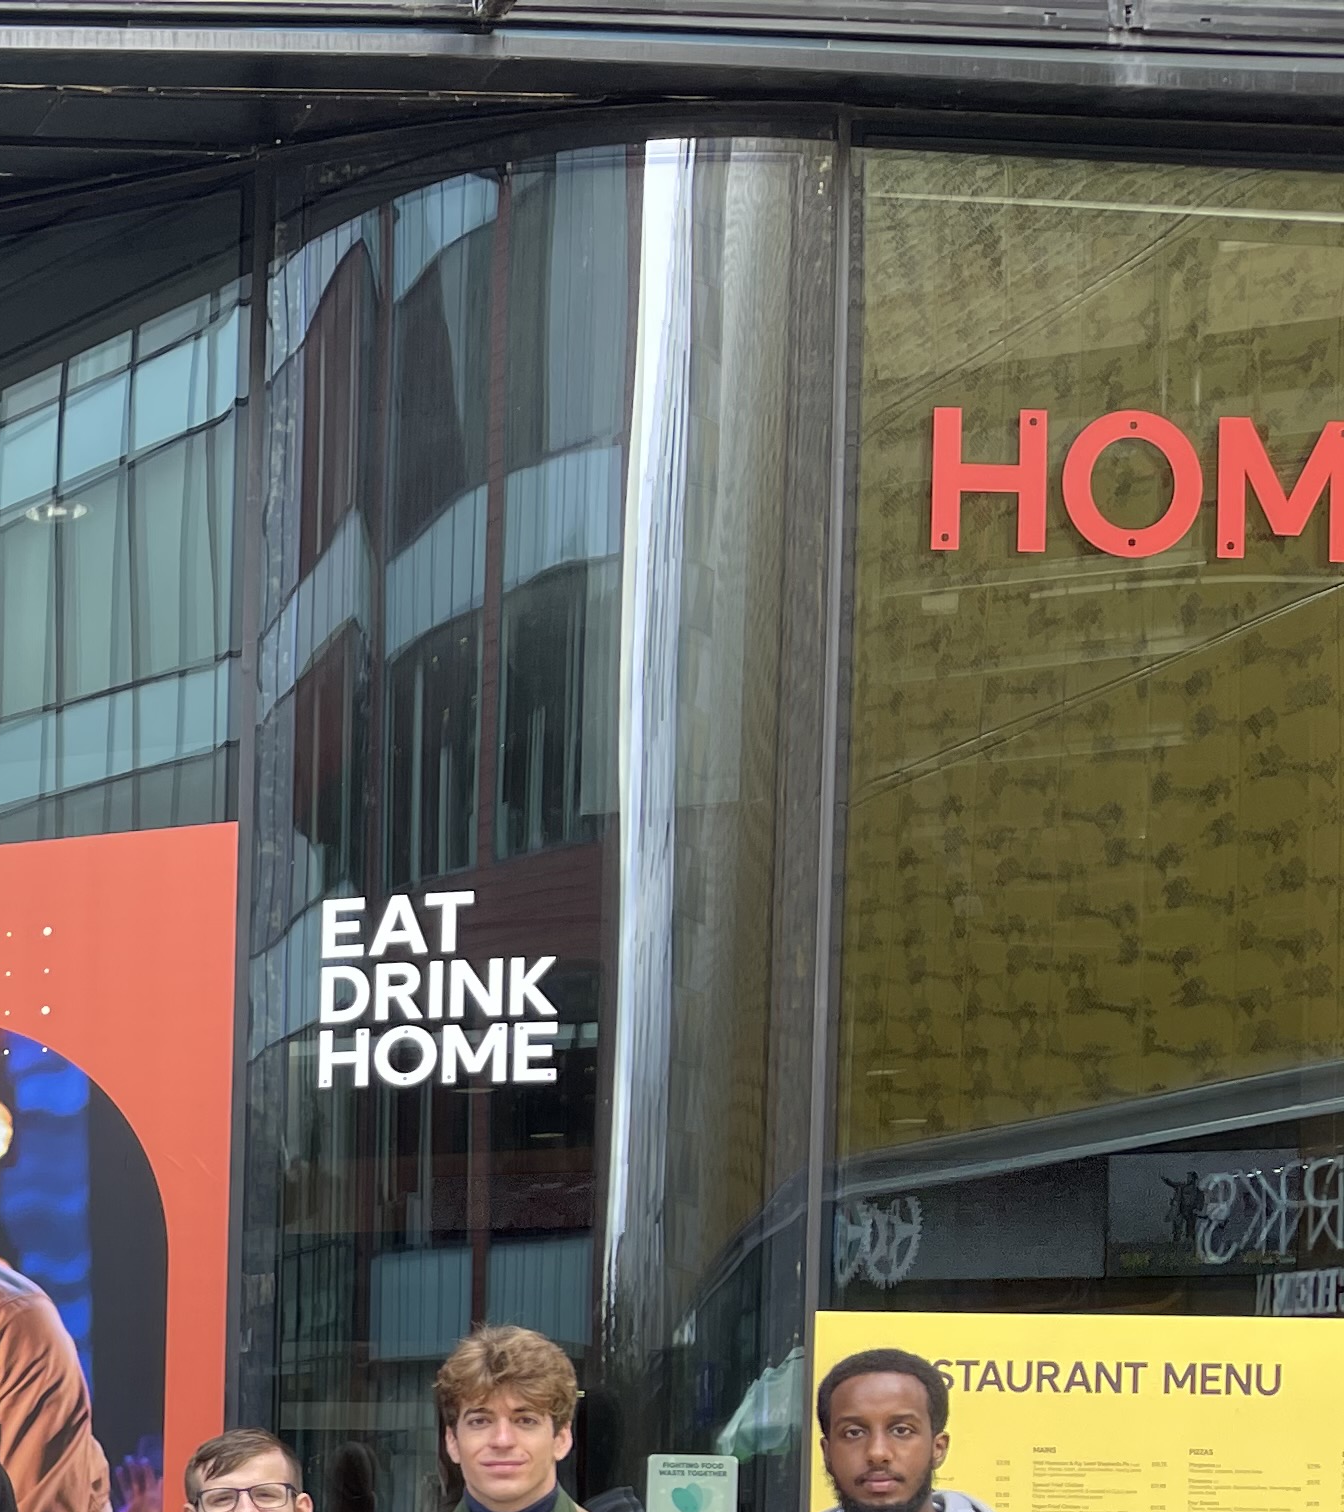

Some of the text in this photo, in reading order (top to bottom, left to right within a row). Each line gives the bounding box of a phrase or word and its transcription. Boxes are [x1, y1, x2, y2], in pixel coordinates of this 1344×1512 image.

[930, 406, 1344, 563] HOM
[320, 890, 475, 959] EAT
[319, 955, 557, 1024] DRINK
[317, 1021, 559, 1089] HOME
[1163, 1363, 1283, 1397] MENU
